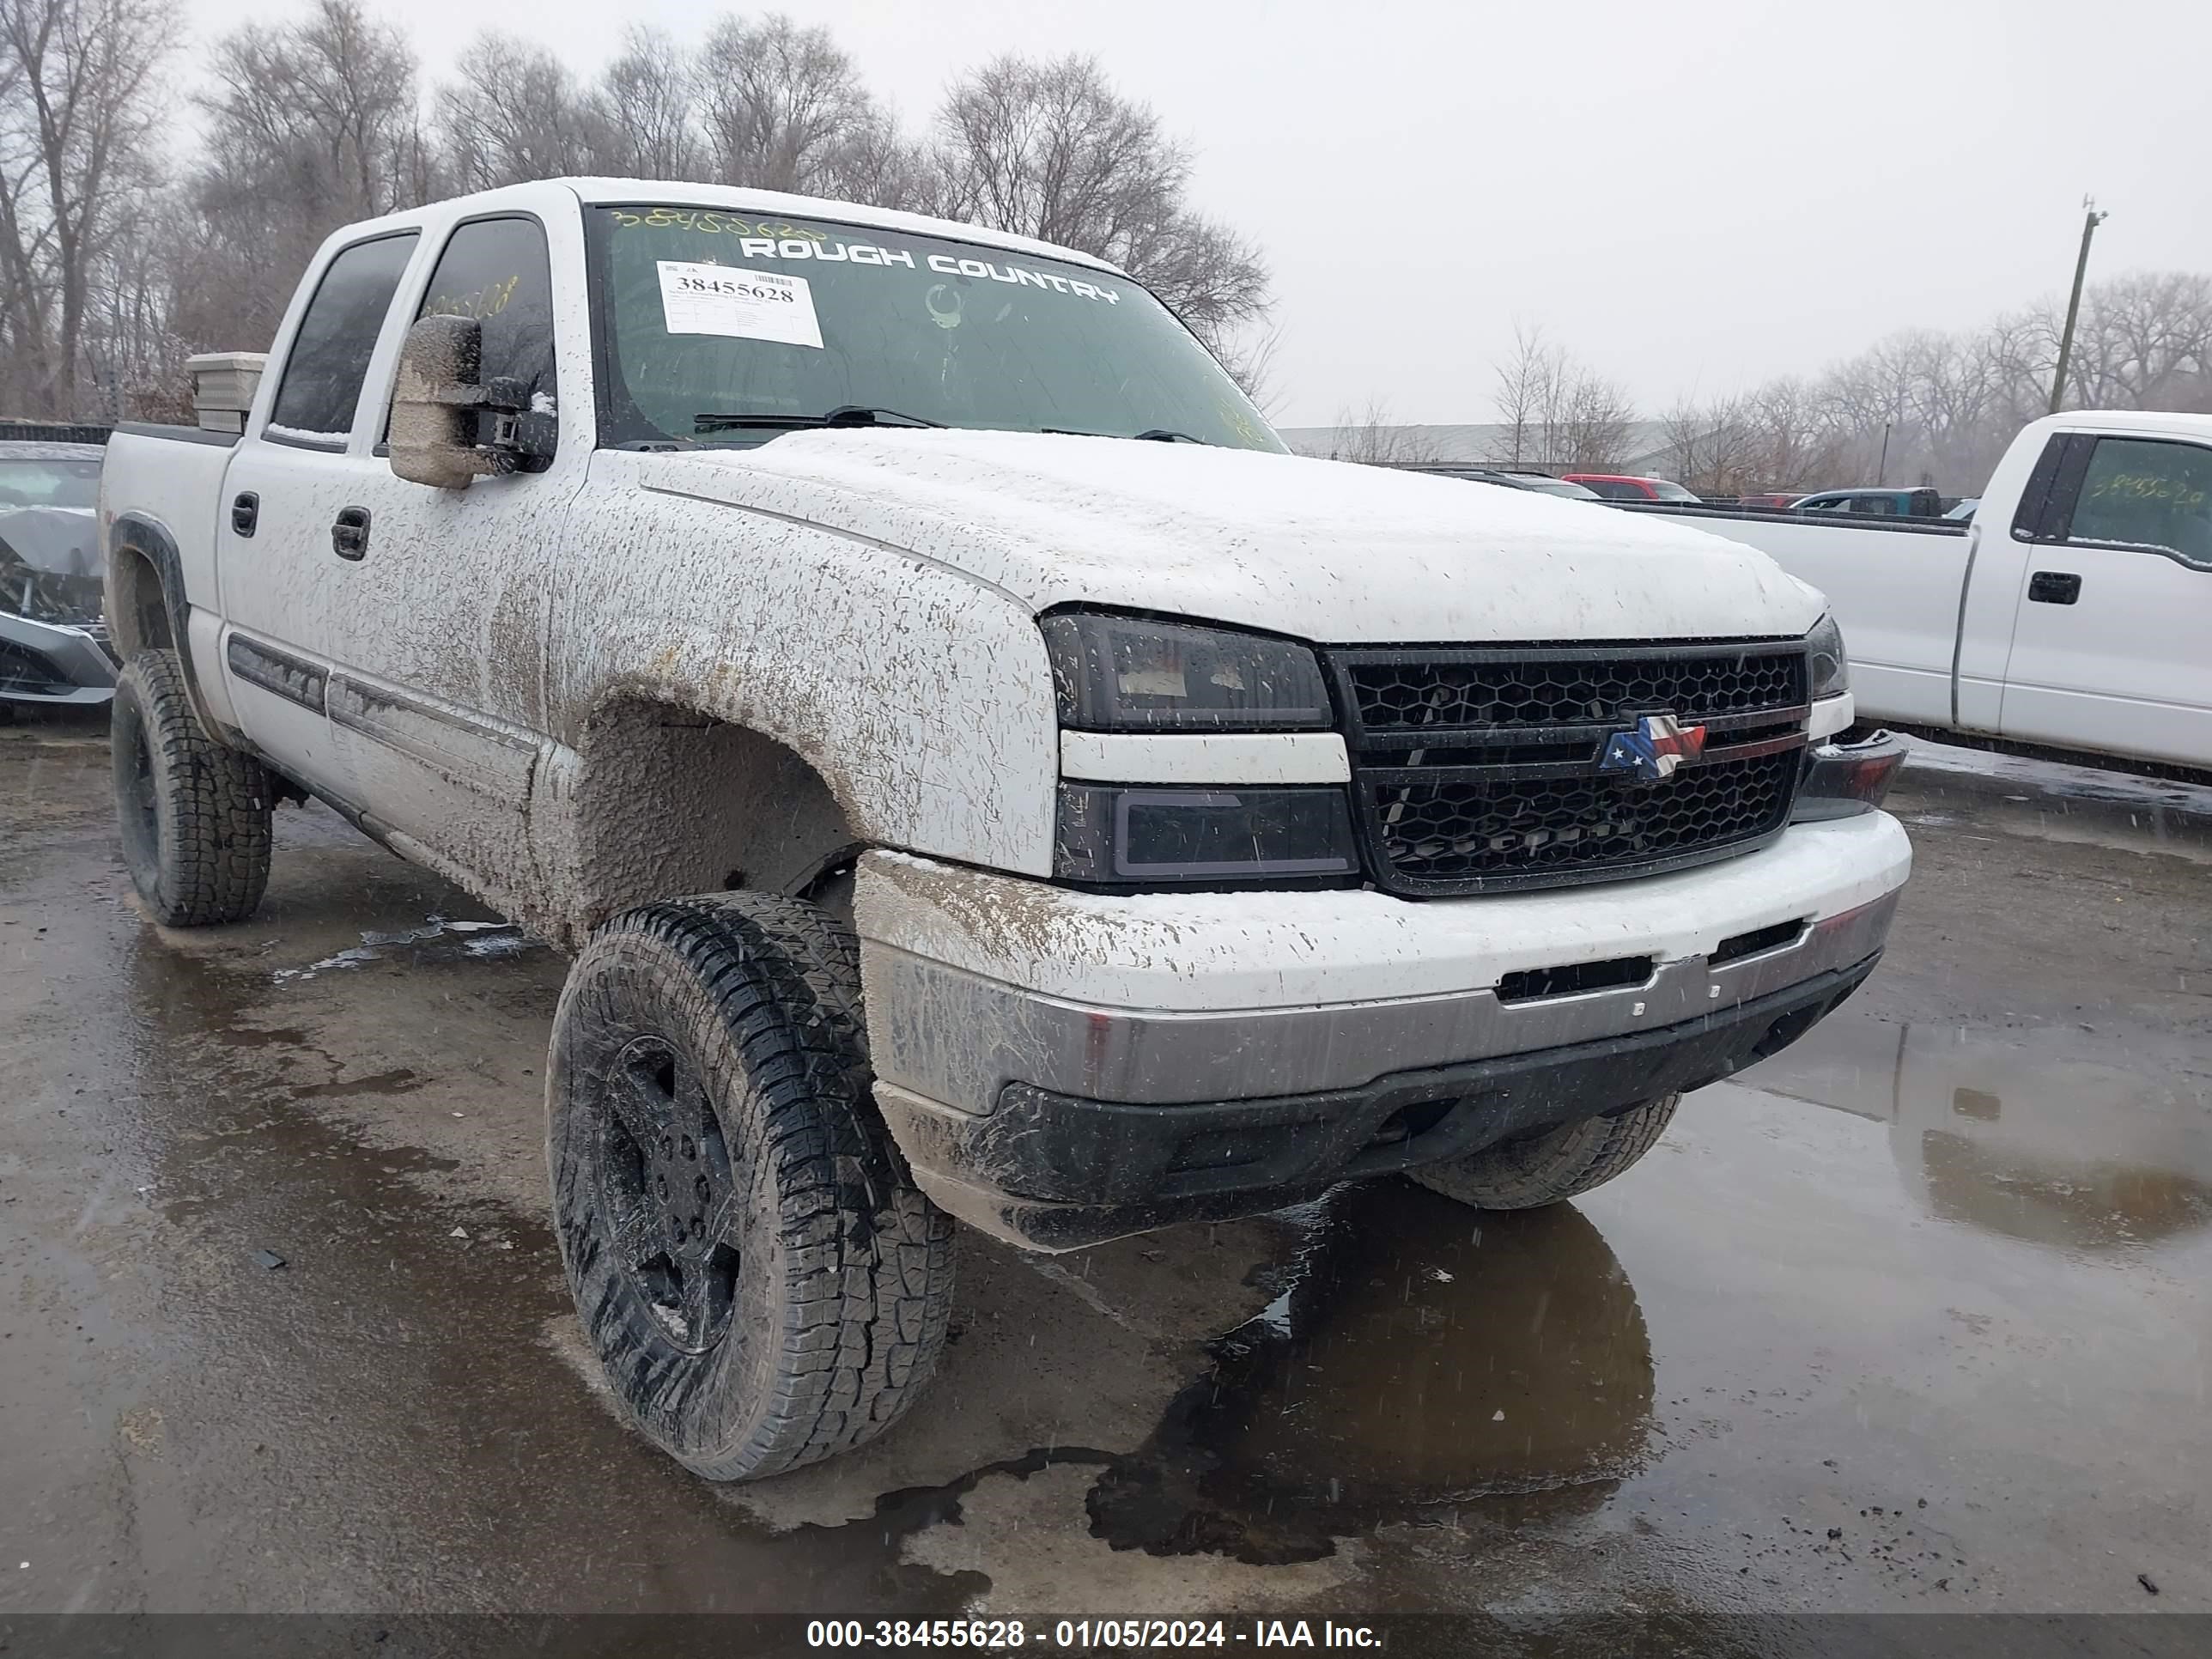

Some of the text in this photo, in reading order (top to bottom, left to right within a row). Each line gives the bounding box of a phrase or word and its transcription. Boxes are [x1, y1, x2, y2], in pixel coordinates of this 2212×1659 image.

[676, 276, 794, 303] 38455628
[738, 237, 1121, 307] ROUGH COUNTRY
